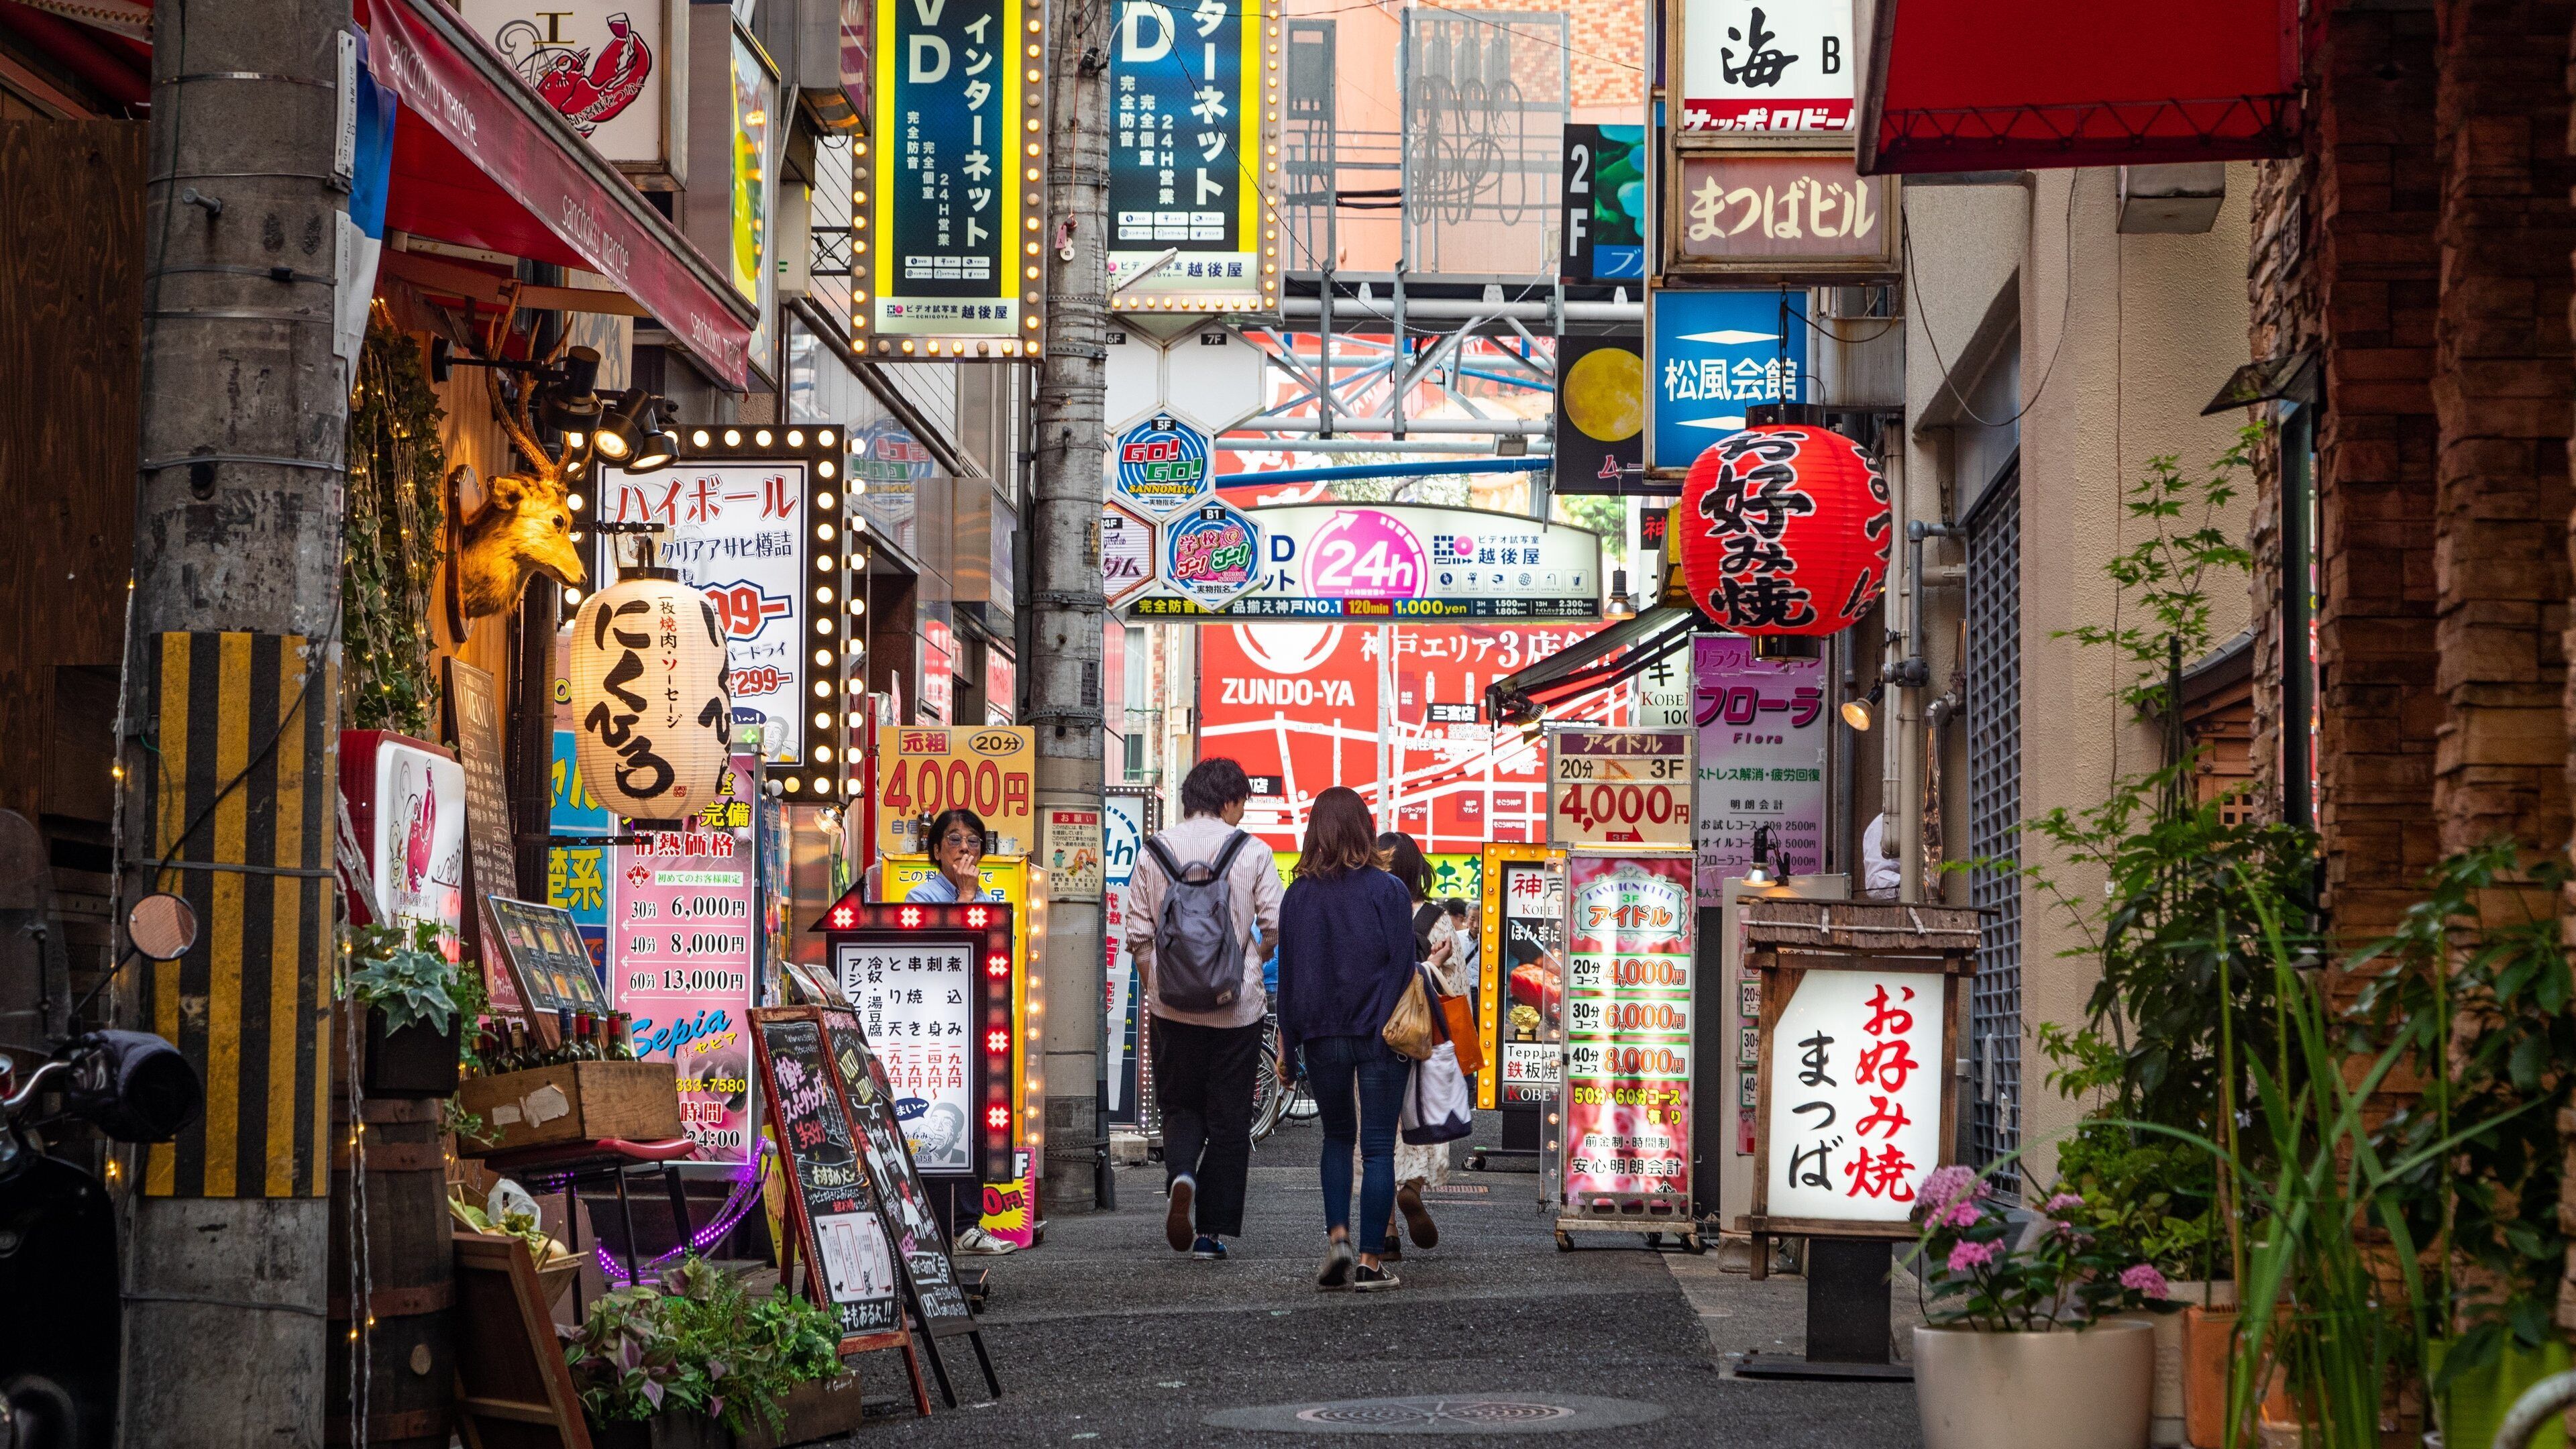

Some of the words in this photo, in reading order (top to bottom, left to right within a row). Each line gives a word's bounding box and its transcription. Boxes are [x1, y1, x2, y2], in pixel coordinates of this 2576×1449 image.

[1721, 7, 1799, 88] 海
[1120, 76, 1135, 147] 完全防音
[906, 111, 919, 169] 完全防音
[962, 13, 993, 247] インターネット
[1140, 95, 1155, 166] 完全個室
[922, 142, 935, 199] 完全個室
[1160, 115, 1175, 205] 24H営業
[937, 174, 950, 246] 24H営業
[1569, 144, 1590, 256] 2F
[1688, 175, 1876, 241] まつばビル
[562, 195, 600, 255] sanchoku
[602, 229, 630, 280] marche
[1187, 262, 1242, 278] 越後屋
[906, 305, 958, 313] ビデオ試写室
[961, 305, 1008, 319] 越後屋
[1107, 335, 1120, 343] 6F
[1208, 334, 1222, 344] 7F
[1665, 358, 1797, 401] 松風会館
[1157, 421, 1171, 429] 5F
[1122, 438, 1181, 464] GO!
[1145, 456, 1203, 482] GO!
[614, 474, 800, 529] ハイボール
[1128, 484, 1197, 494] SANNOMIYA
[1206, 510, 1220, 519] B1
[1479, 535, 1540, 544] ビデオ試写室
[1699, 430, 1817, 627] お好み焼
[659, 531, 794, 564] クリアアサヒ樽詰
[1479, 547, 1540, 564] 越後屋
[1316, 539, 1413, 587] 24h
[1197, 585, 1230, 594] 実物指名
[1348, 600, 1389, 614] 120min
[584, 600, 675, 800] にくひろ
[1221, 678, 1355, 706] ZUNDO-YA
[1433, 705, 1476, 721] 三宮店
[1695, 686, 1823, 729] フローラ
[903, 733, 947, 753] 元祖
[976, 737, 1020, 751] 20分
[1583, 734, 1663, 753] アイドル
[1733, 732, 1784, 744] Flora
[1560, 759, 1593, 779] 20分
[1650, 759, 1684, 778] 3F
[1559, 784, 1689, 833] 4,000円
[1730, 799, 1784, 810] 明朗会計
[1061, 814, 1092, 822] お願い
[1701, 819, 1758, 831] お試しコース
[1785, 820, 1816, 832] 2500円
[634, 831, 735, 857] 情熱価格
[1785, 839, 1816, 849] 5000円
[657, 873, 741, 885] 初めてのお客様限定
[1511, 873, 1564, 900] 神戸
[631, 902, 657, 919] 30分
[671, 896, 745, 919] 6,000円
[1622, 894, 1640, 903] 3F
[1589, 906, 1672, 928] アイドル
[631, 936, 657, 953] 40分
[671, 933, 745, 955] 8,000円
[1511, 924, 1561, 942] ほんまに
[630, 973, 655, 989] 60分
[663, 970, 744, 993] 13,000円
[1573, 959, 1601, 974] 20分
[1604, 959, 1686, 987] 4,000円
[1576, 977, 1599, 985] コース
[867, 956, 883, 1037] 冷奴・湯豆腐
[888, 957, 903, 1036] とり天
[907, 956, 922, 1036] 串焼き
[927, 957, 943, 1036] 刺身
[947, 956, 962, 1036] 煮込み
[1572, 1004, 1600, 1018] 30分
[1603, 1003, 1685, 1032] 6,000円
[1576, 1021, 1599, 1029] コース
[632, 1010, 732, 1059] Sepia
[694, 1032, 737, 1054] セピア
[947, 1044, 962, 1088] 一九九円
[1507, 1061, 1558, 1079] 鉄板焼
[1572, 1047, 1599, 1063] 40分
[1603, 1047, 1685, 1076] 8,000円
[1575, 1064, 1598, 1073] コース
[1574, 1087, 1682, 1106] 50分・60分コース
[1843, 983, 1919, 1202] お好み焼
[1789, 1030, 1843, 1191] まつば
[1585, 1136, 1670, 1149] 前金制・時間制
[1572, 1159, 1682, 1175] 安心明朗会計
